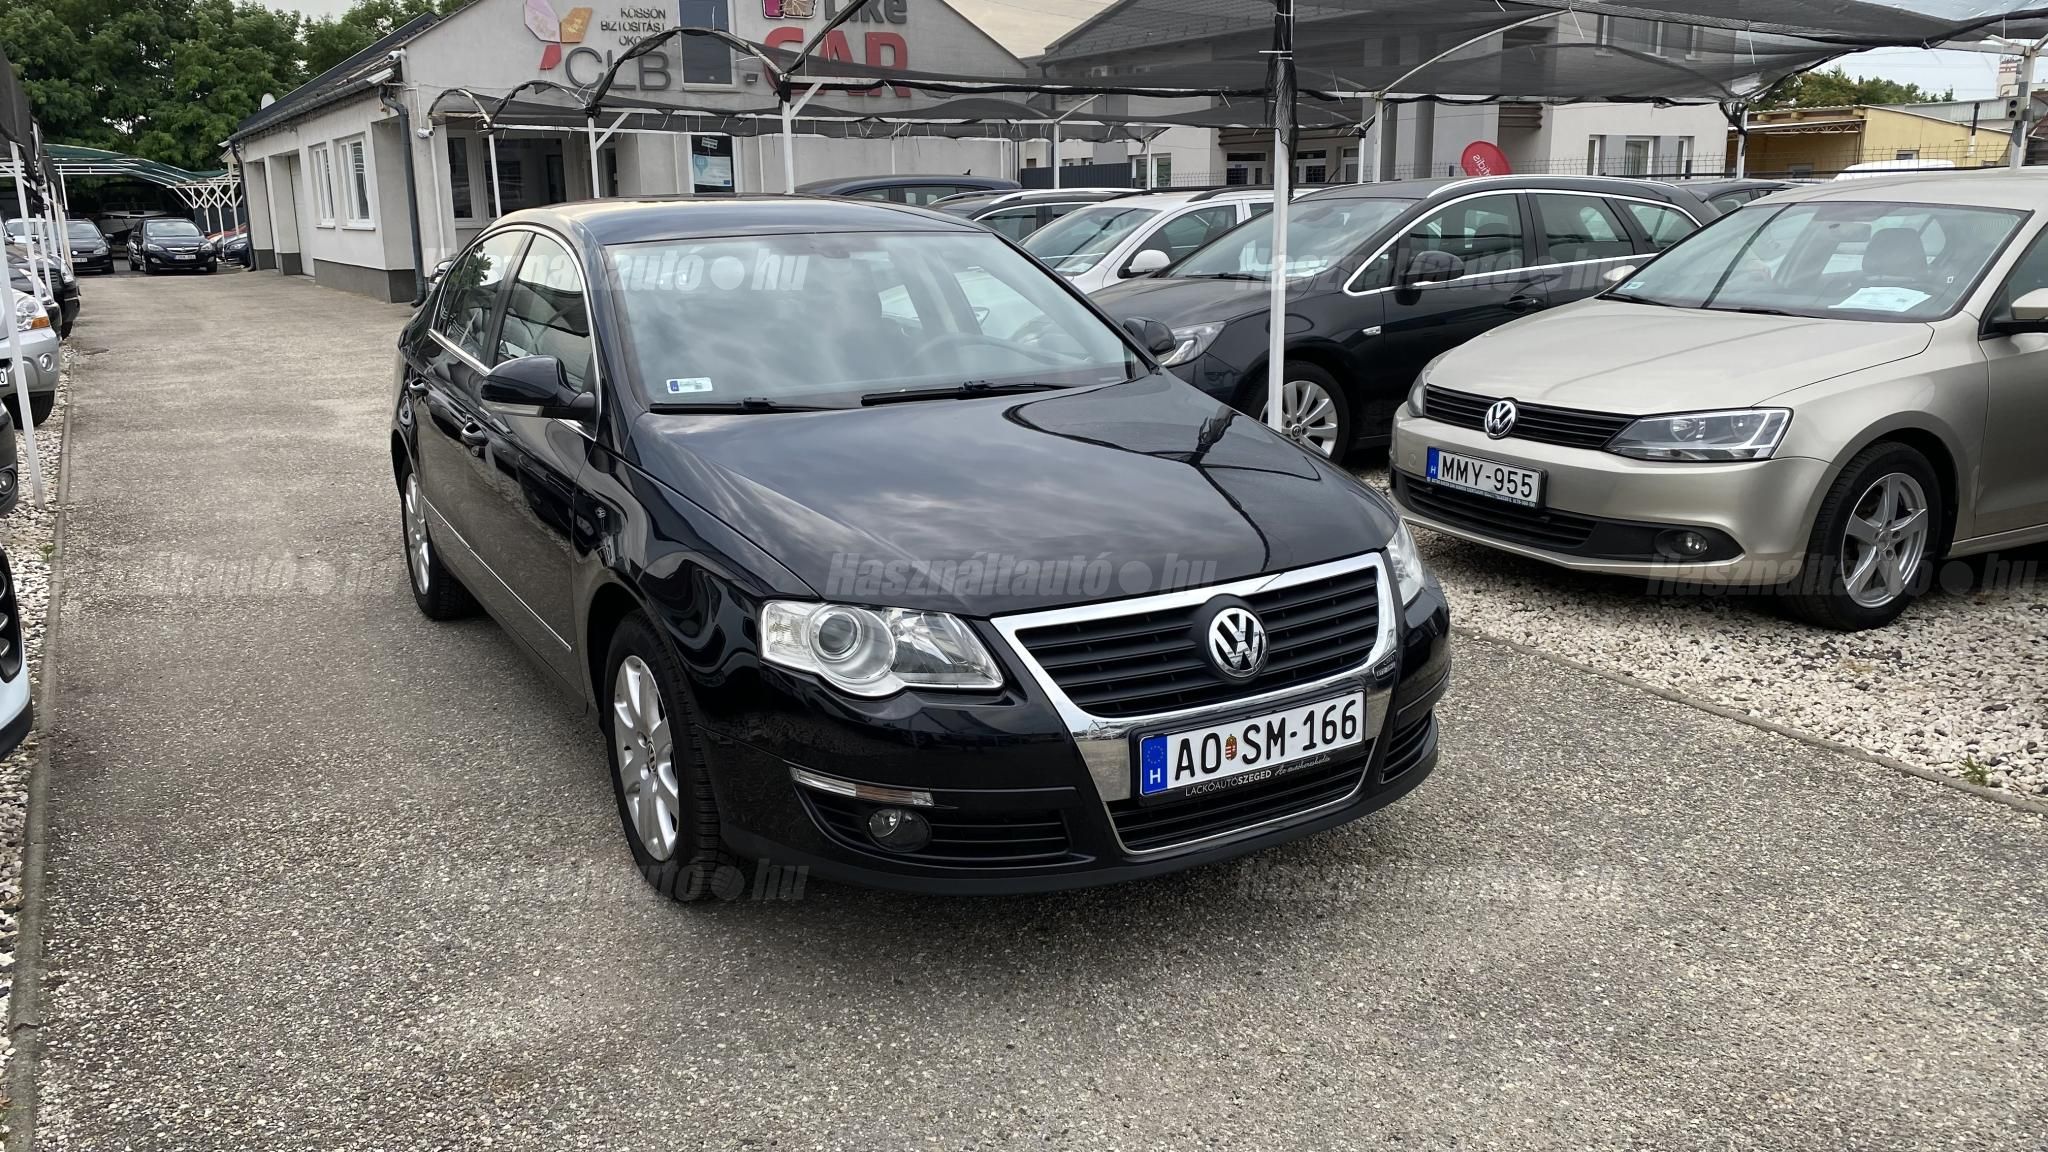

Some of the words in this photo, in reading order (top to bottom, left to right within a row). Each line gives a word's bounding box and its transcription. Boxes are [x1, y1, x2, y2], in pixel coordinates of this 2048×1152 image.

[565, 47, 671, 90] CLB
[763, 26, 912, 98] CAR
[1441, 455, 1533, 498] MMY-955
[1149, 767, 1161, 785] H
[1241, 699, 1357, 765] SM-166
